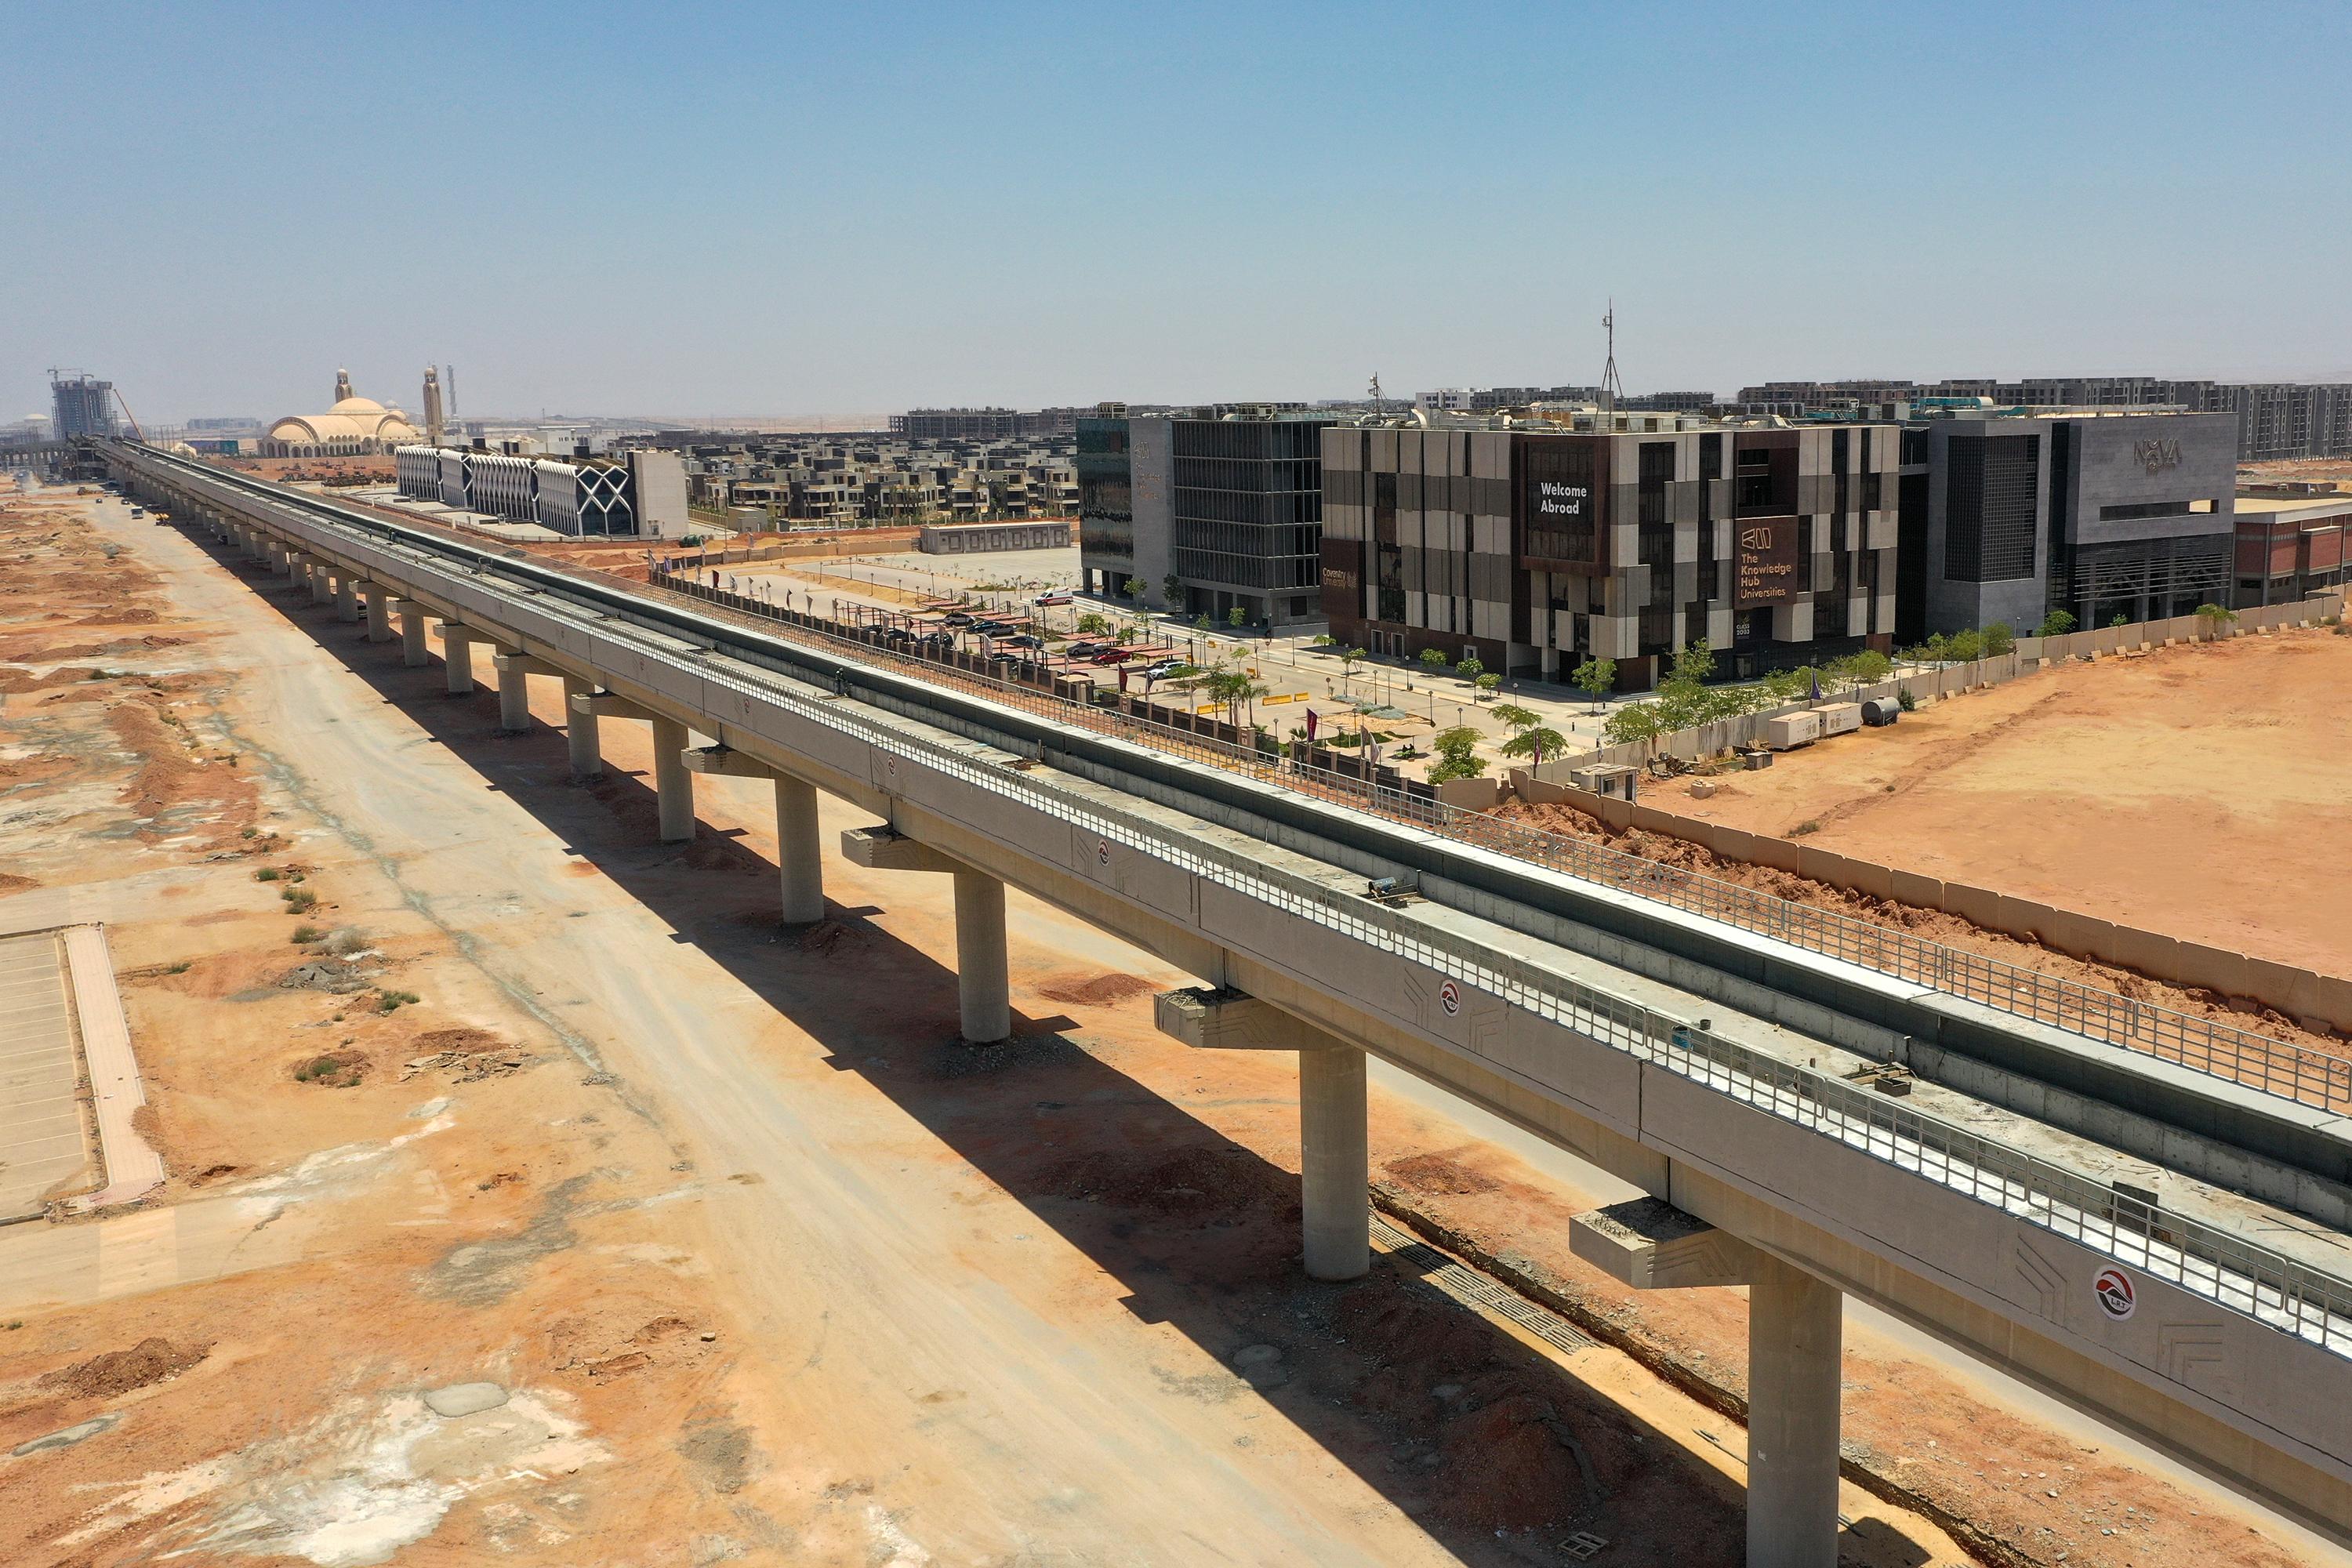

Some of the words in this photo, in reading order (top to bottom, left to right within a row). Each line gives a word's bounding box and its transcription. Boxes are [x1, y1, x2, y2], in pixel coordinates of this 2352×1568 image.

[1541, 482, 1587, 497] Welcome
[1541, 499, 1579, 514] Abroad
[1741, 553, 1758, 564] The
[1741, 563, 1791, 575] Knowledge
[1740, 575, 1760, 587] Hub
[1740, 586, 1786, 599] Universities
